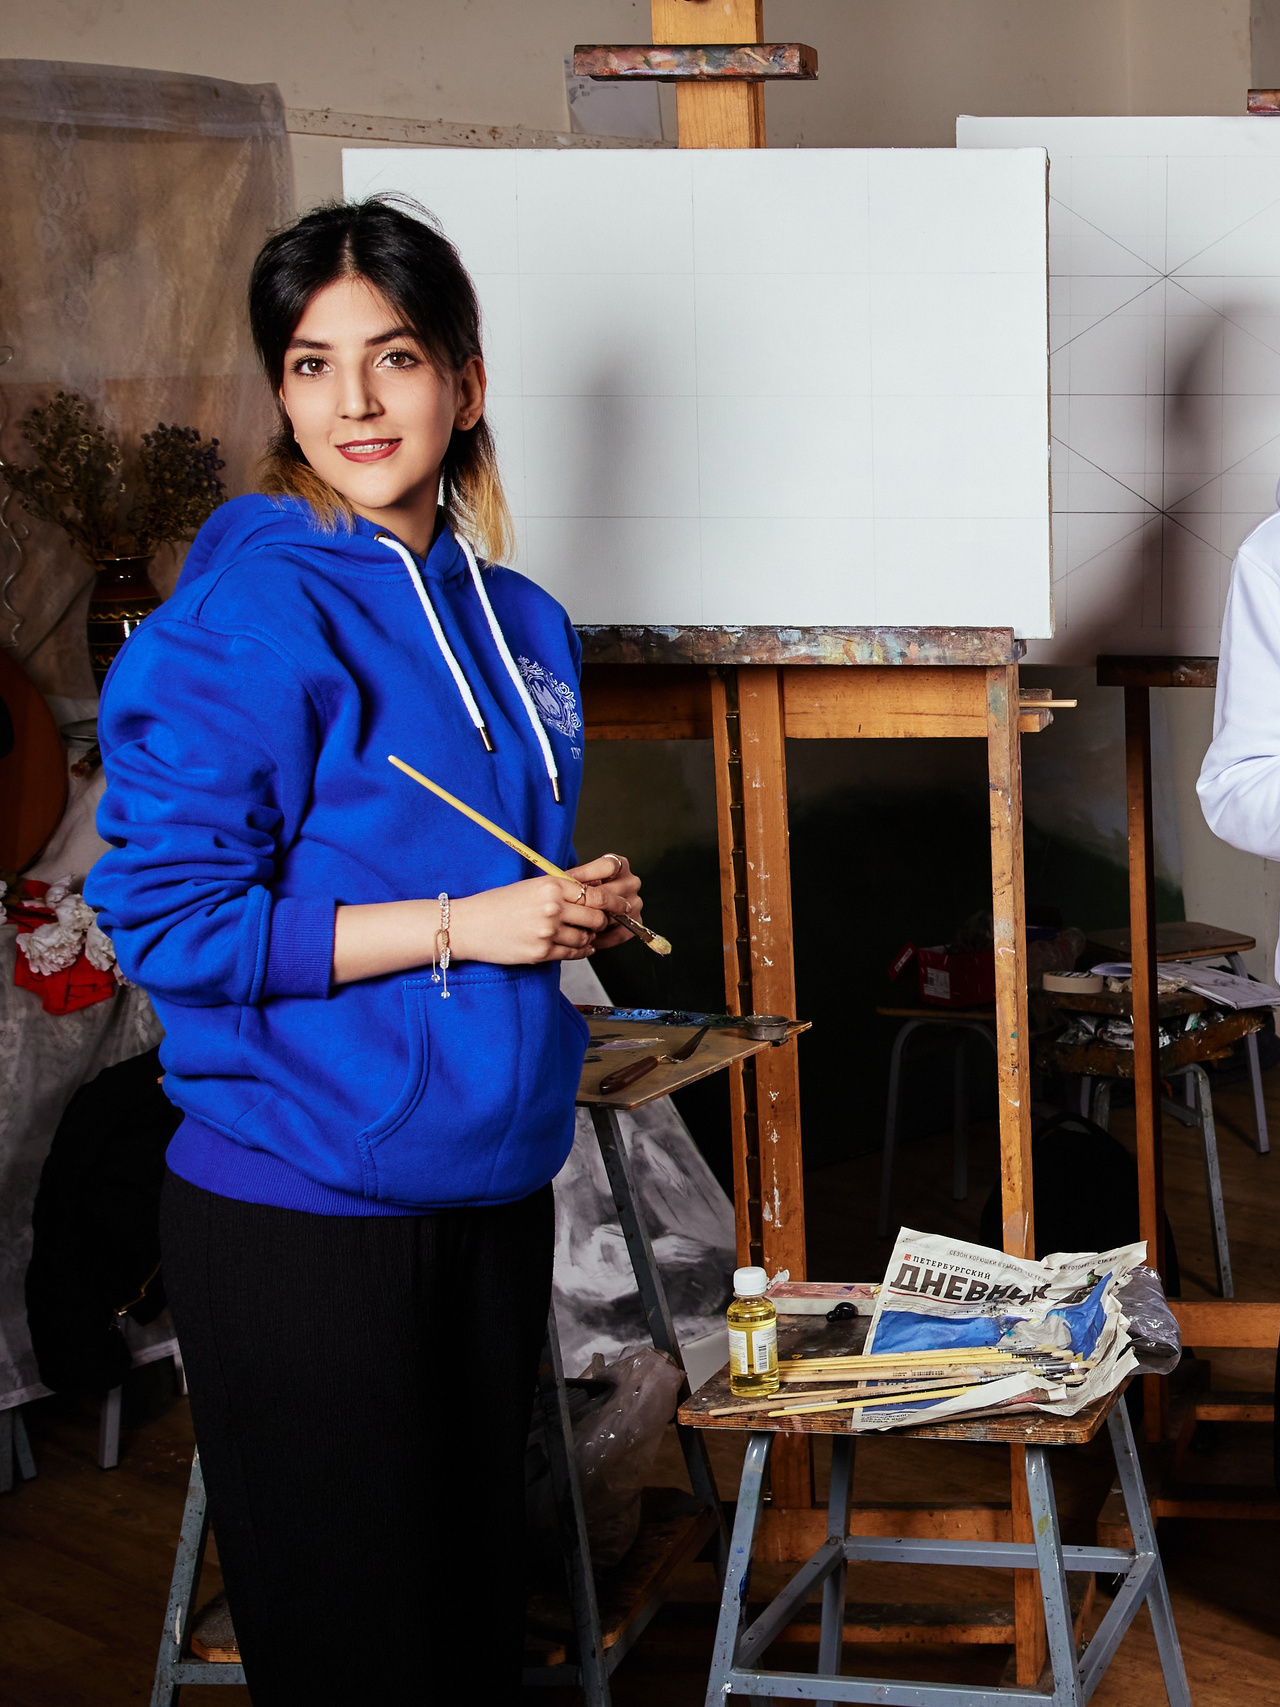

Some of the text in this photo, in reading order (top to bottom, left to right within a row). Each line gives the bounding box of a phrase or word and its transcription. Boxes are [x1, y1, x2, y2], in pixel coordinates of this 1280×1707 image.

[912, 1255, 991, 1280] ПЕТЕРБУРГСКИЙ
[949, 1249, 968, 1259] СЕЗОН
[969, 1254, 997, 1266] КОРЮШКИ
[889, 1262, 1052, 1306] ДНЕВНИК
